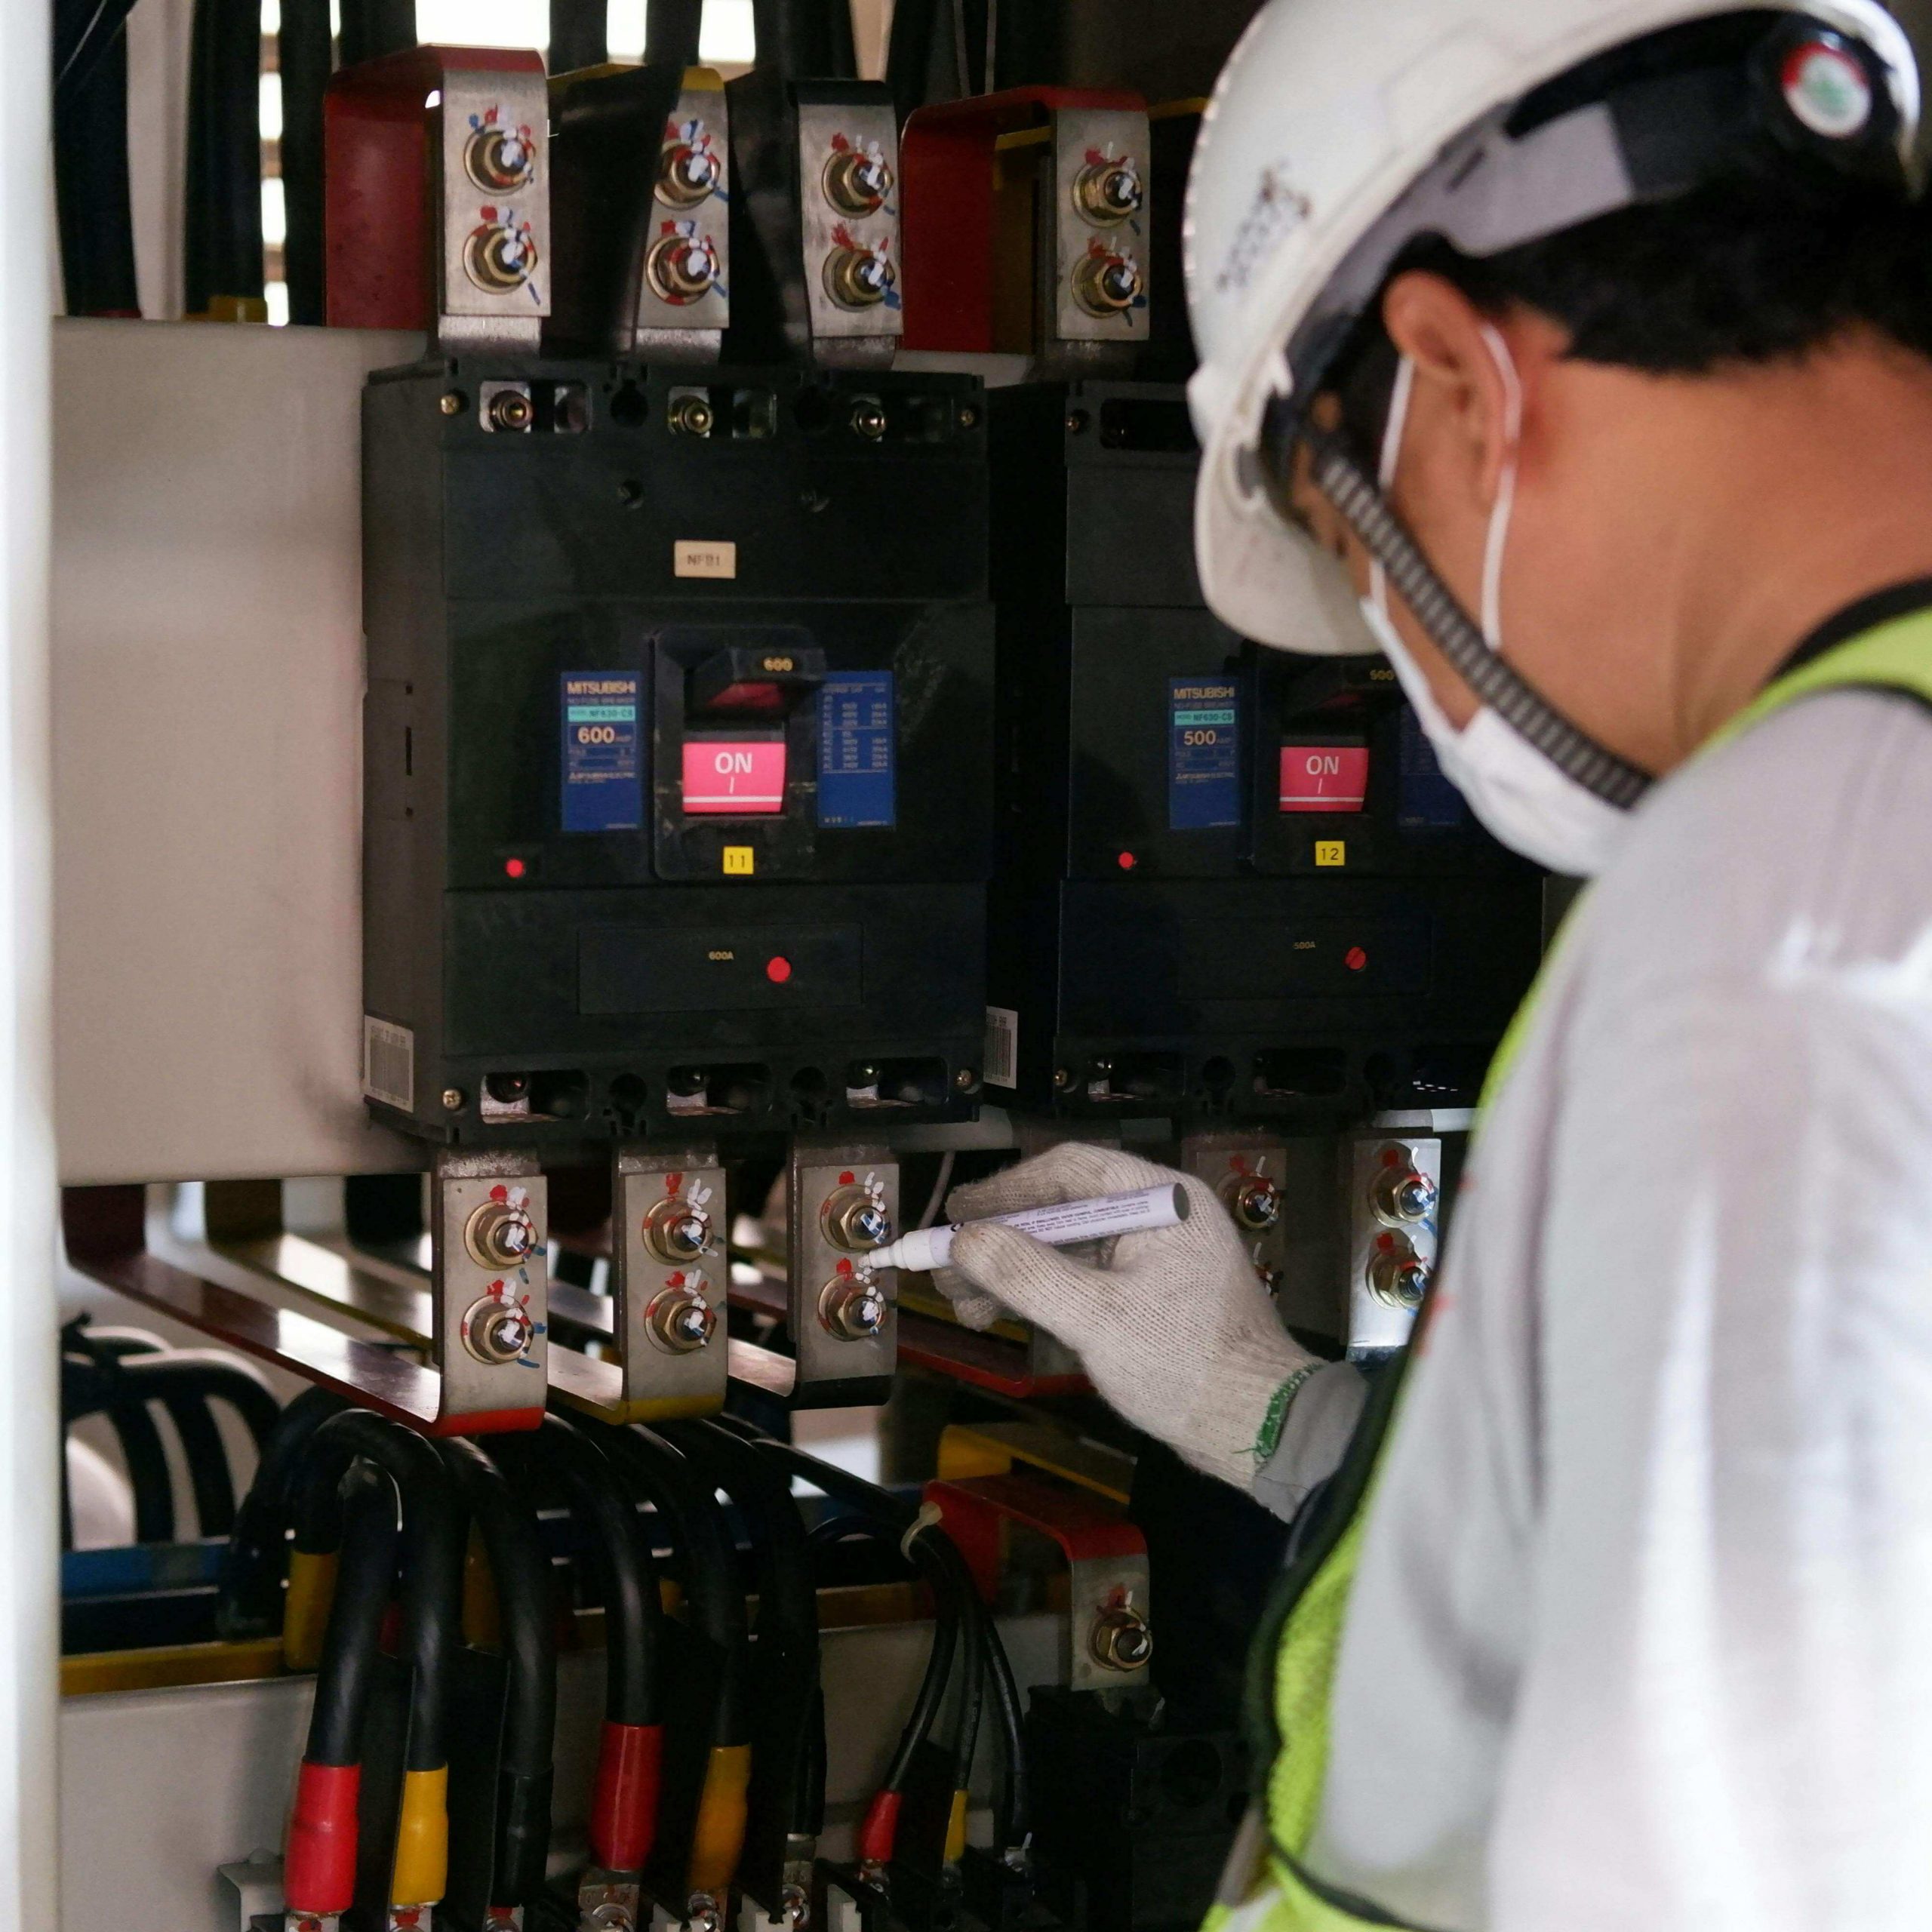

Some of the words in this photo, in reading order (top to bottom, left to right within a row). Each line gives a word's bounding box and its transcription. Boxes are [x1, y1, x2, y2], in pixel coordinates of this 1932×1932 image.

[763, 657, 792, 672] 600
[567, 681, 636, 694] MITSUBISHI
[1174, 687, 1235, 700] MITSUBISHI
[577, 726, 615, 744] 600
[1183, 730, 1217, 746] 500
[715, 752, 752, 774] ON
[1306, 755, 1340, 776] ON
[729, 854, 745, 868] 11
[1321, 848, 1340, 861] 12
[1292, 941, 1317, 949] 500A
[709, 951, 734, 960] 600A
